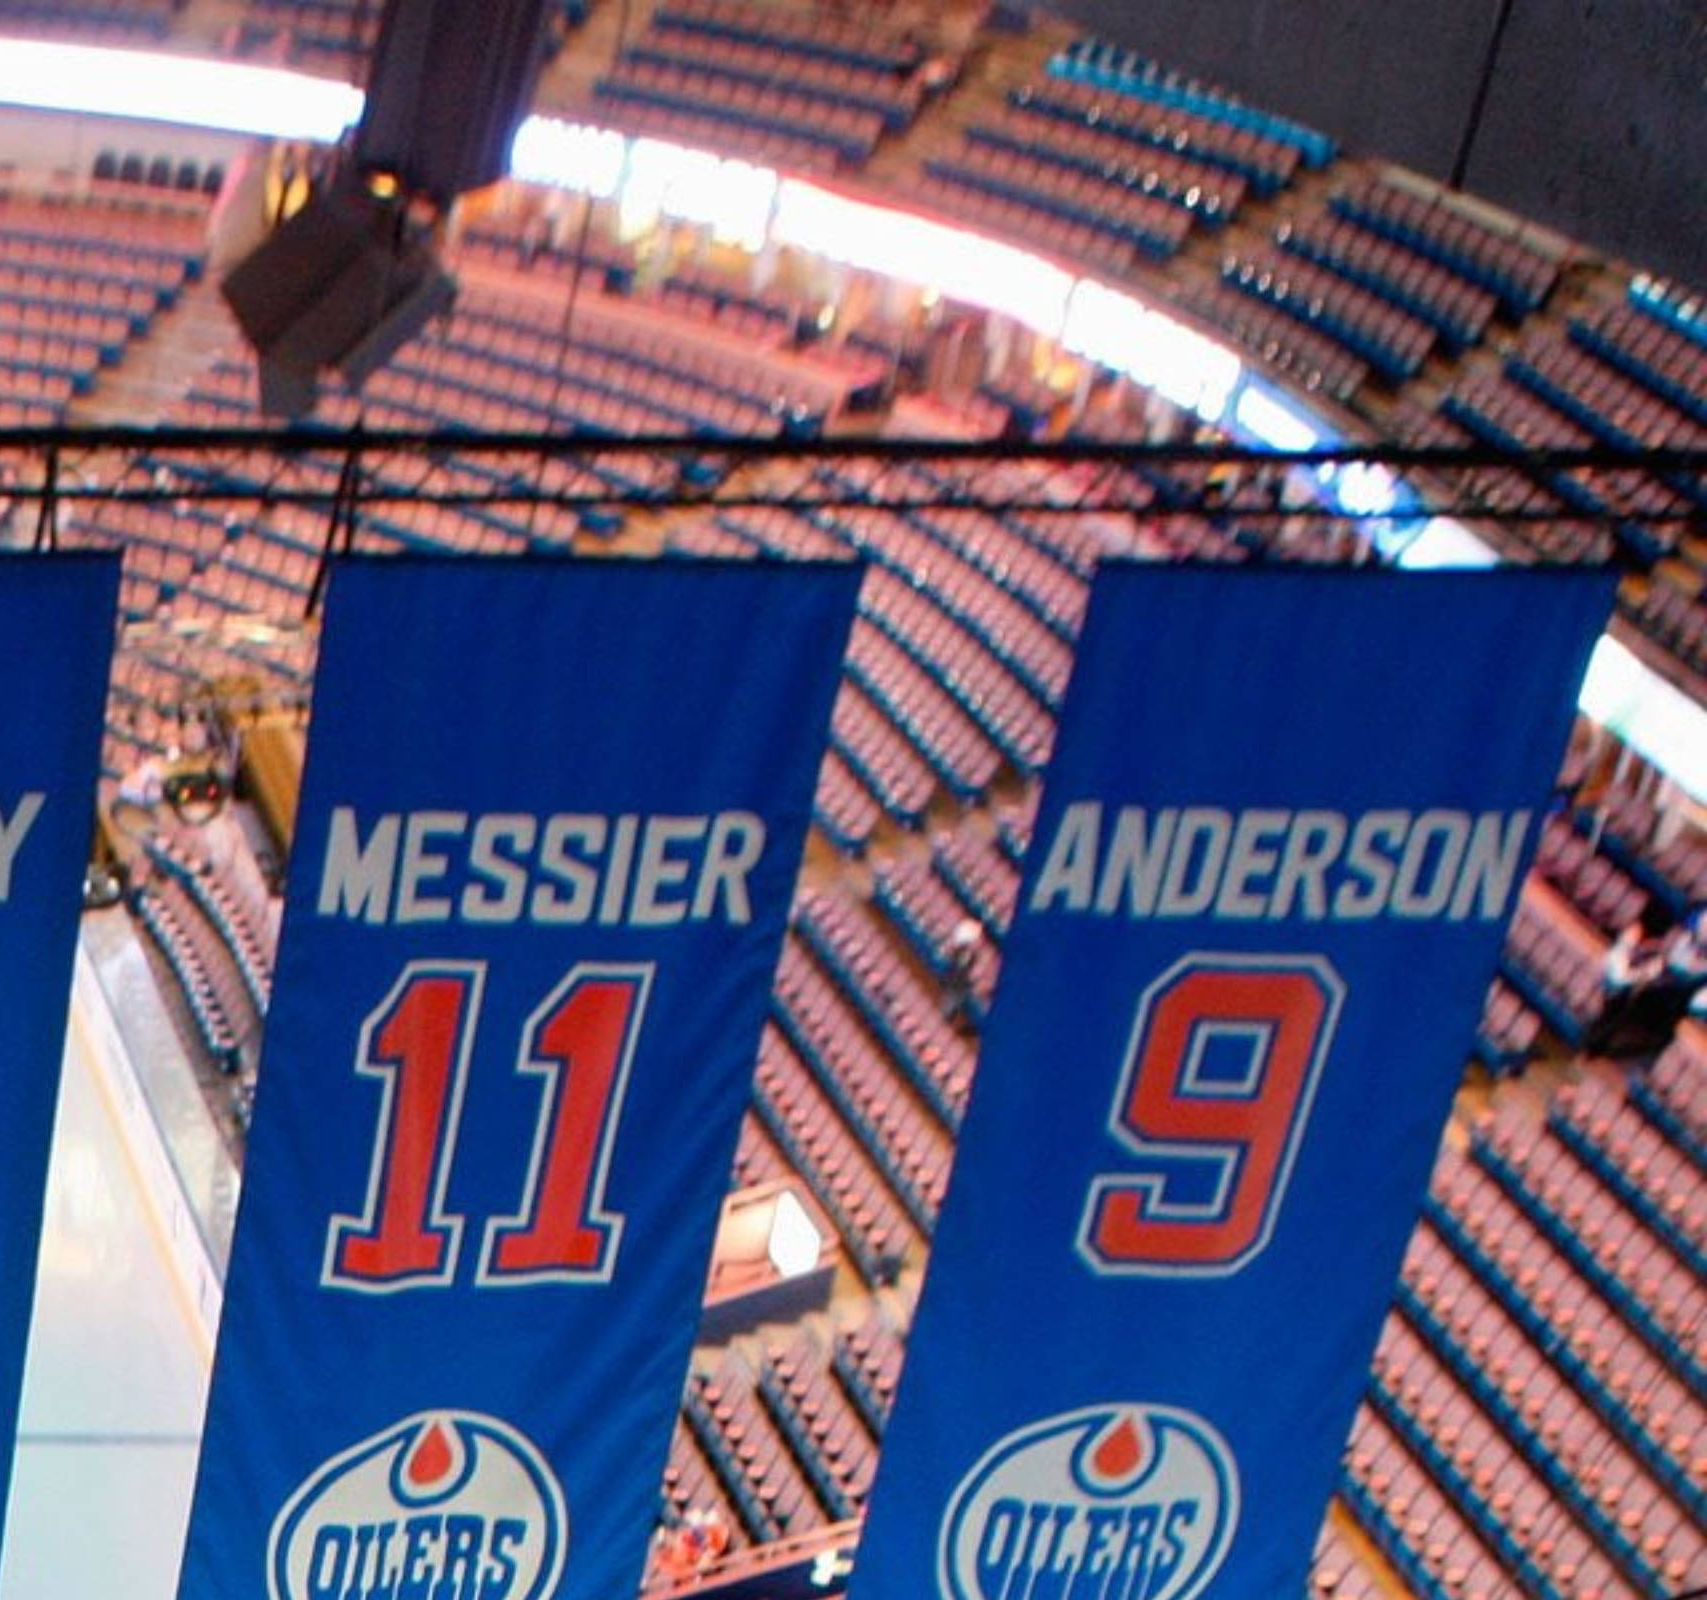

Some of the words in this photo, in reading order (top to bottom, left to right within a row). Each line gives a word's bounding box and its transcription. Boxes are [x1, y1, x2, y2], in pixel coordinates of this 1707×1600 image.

[317, 806, 768, 925] MESSIER
[1028, 801, 1533, 921] ANDERSON
[319, 959, 657, 1294] 11
[1074, 950, 1348, 1278] 9
[975, 1497, 1200, 1596] OILERS
